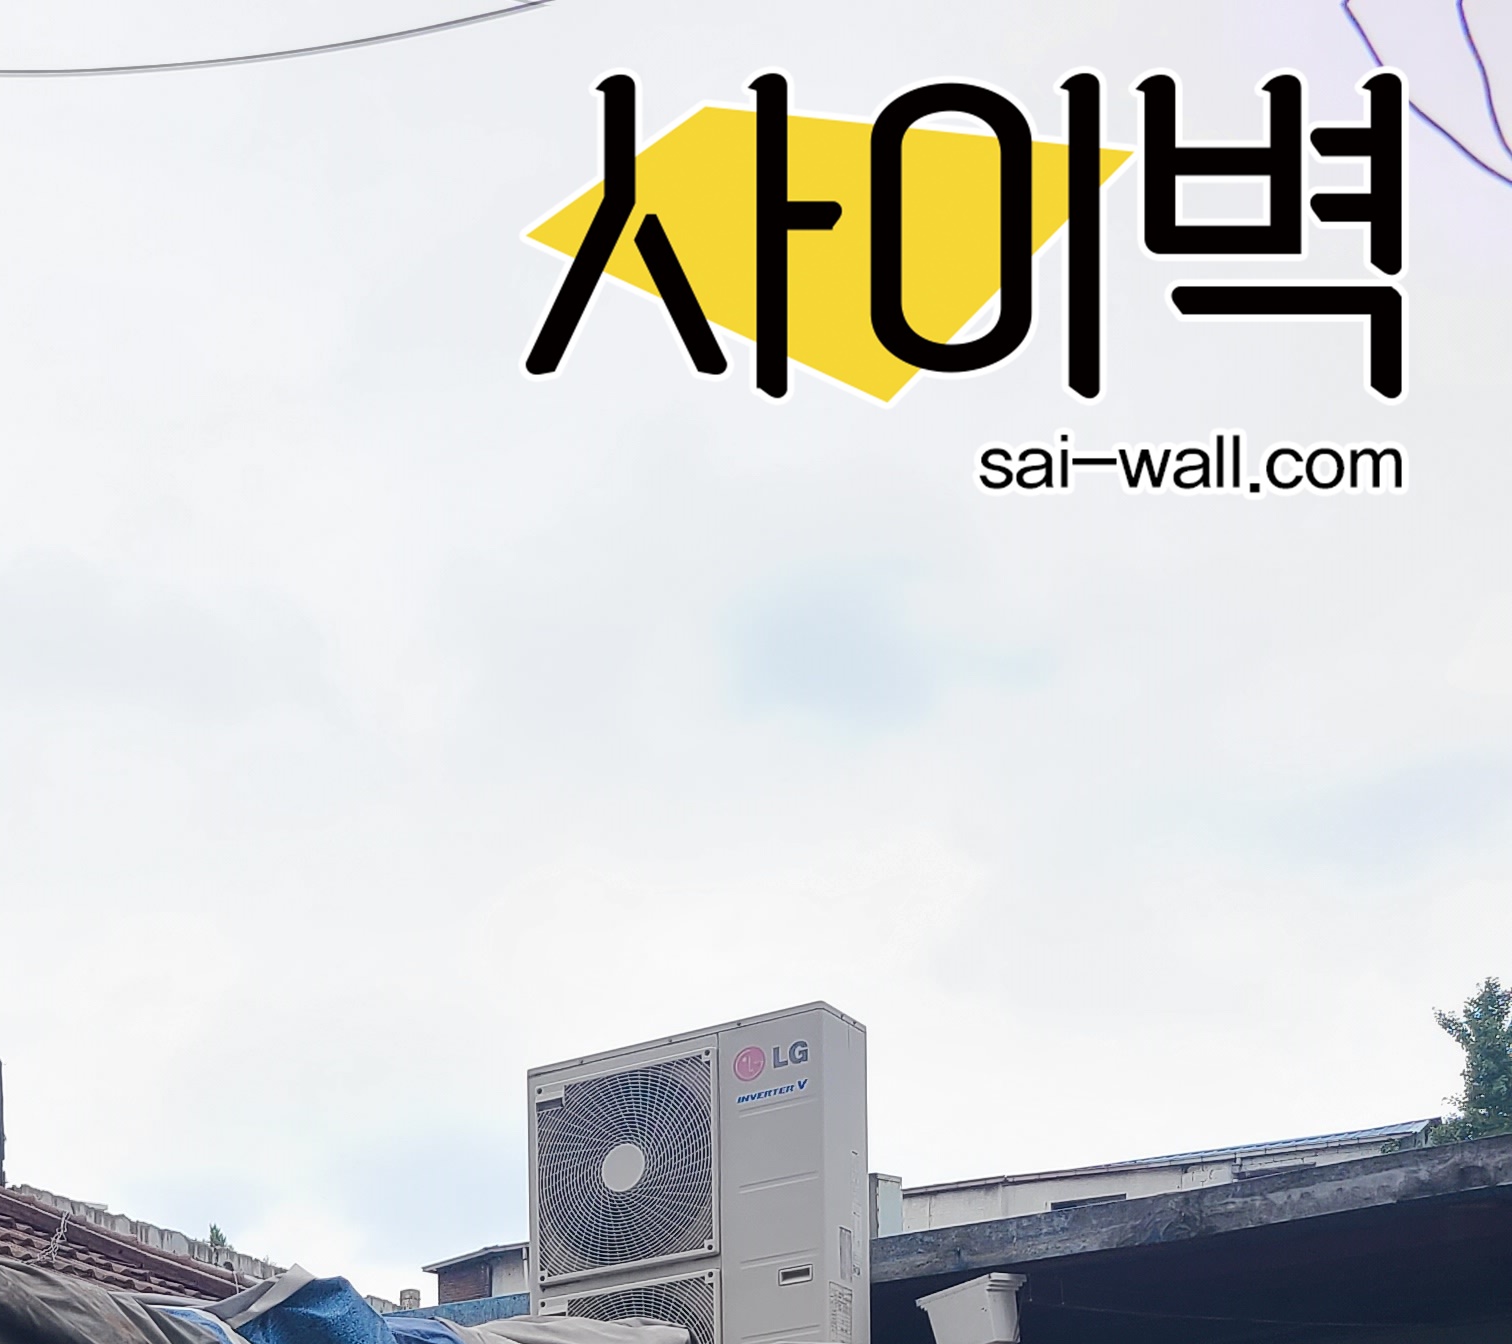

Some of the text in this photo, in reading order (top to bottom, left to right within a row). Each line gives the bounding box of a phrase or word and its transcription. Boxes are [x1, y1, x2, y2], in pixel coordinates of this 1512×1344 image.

[772, 1040, 809, 1069] LG
[736, 1078, 808, 1104] INVERTER V
